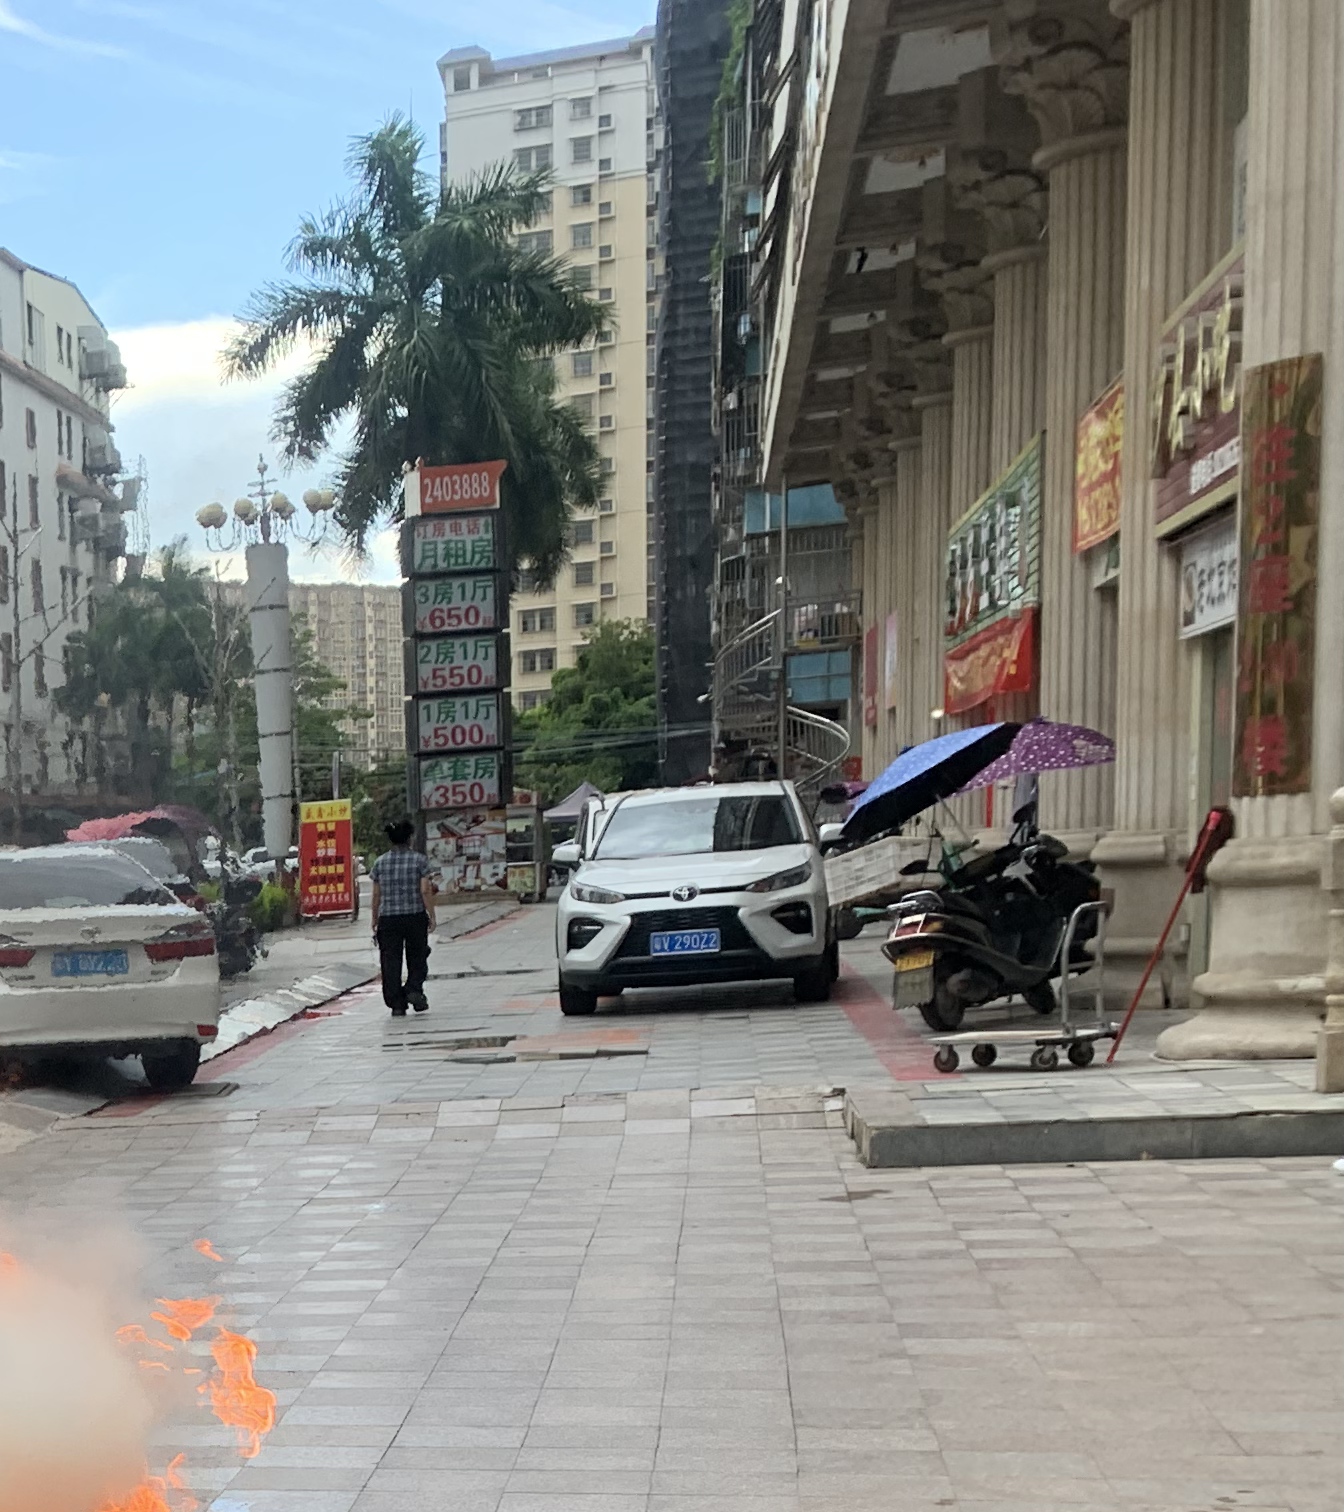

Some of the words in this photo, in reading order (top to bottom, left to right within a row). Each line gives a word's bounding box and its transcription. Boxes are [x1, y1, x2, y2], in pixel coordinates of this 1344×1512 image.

[423, 471, 490, 503] 2403888
[417, 537, 493, 570] 月租房
[416, 579, 493, 605] 3房1厅
[419, 638, 494, 664] 2房1厅
[422, 698, 495, 724] 1房1厅
